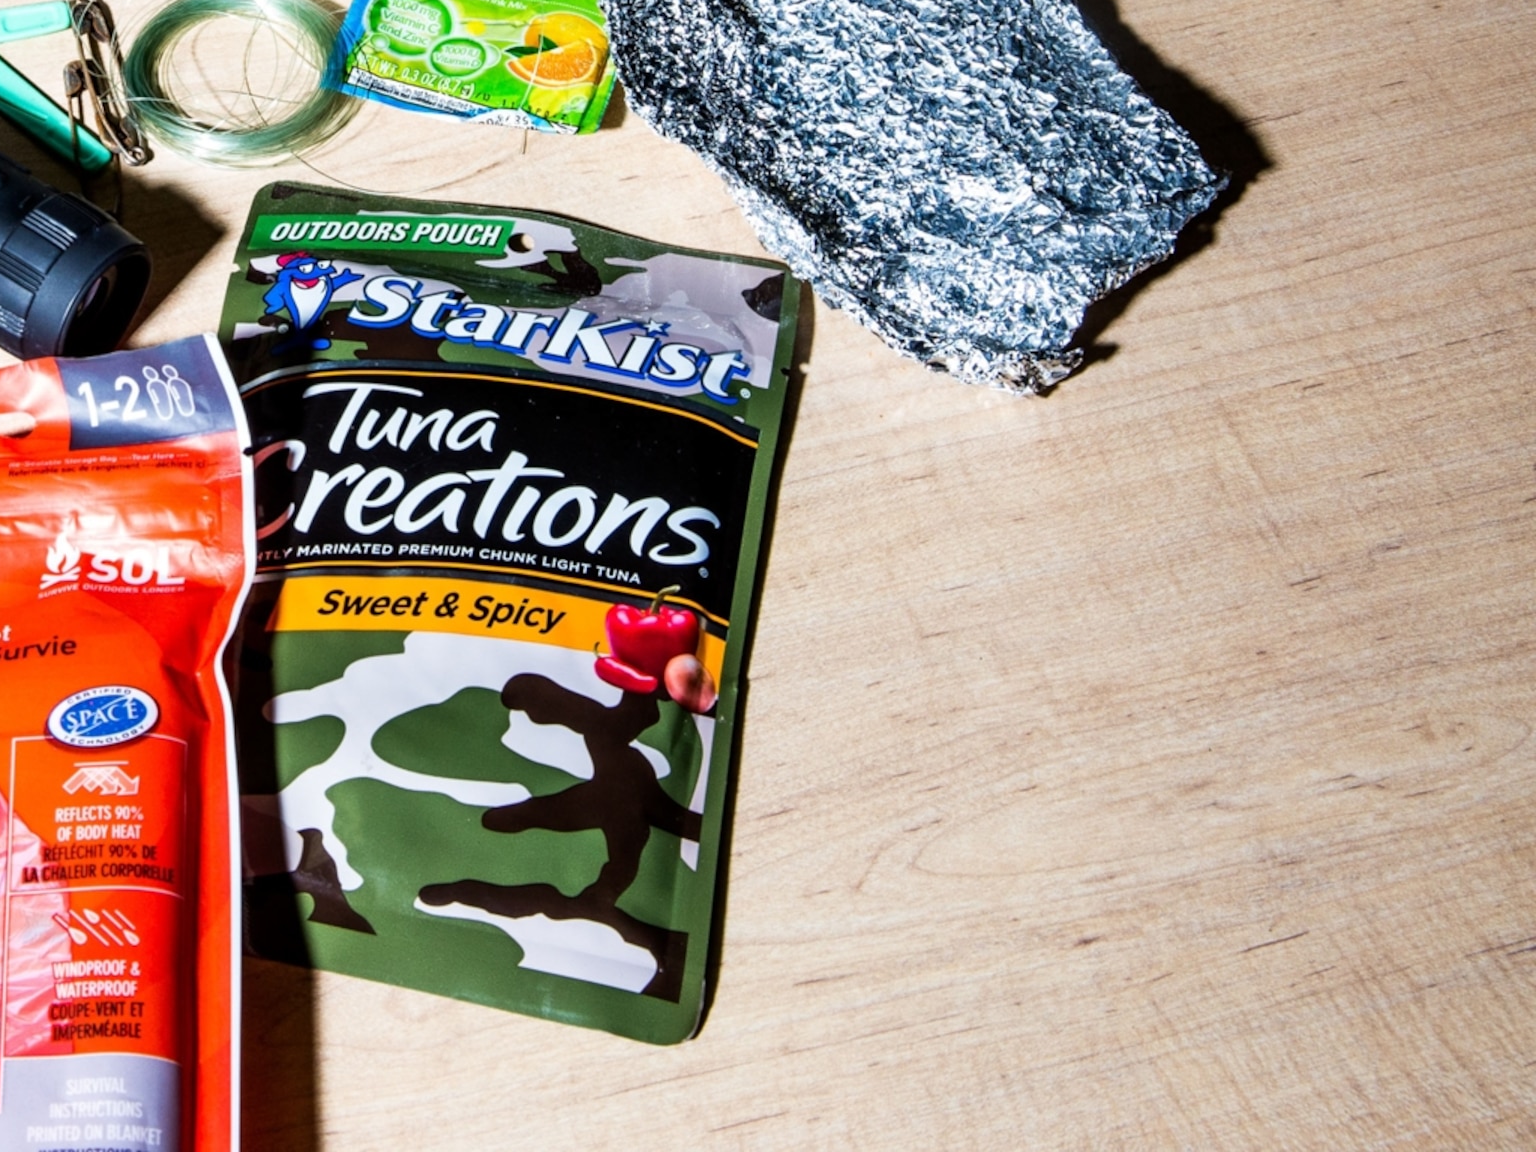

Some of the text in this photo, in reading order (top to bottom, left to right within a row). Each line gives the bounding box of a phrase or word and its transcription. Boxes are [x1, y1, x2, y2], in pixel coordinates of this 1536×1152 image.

[418, 4, 440, 21] mg
[506, 0, 528, 11] Mix
[381, 8, 439, 35] Vitamin C
[378, 22, 430, 46] and Zinc
[433, 51, 481, 68] Vitamin D
[443, 43, 468, 56] 1000
[401, 67, 420, 82] 0.3
[420, 73, 438, 87] OZ
[437, 75, 462, 94] (8.7
[270, 221, 502, 247] OUTDOORS POUCH
[348, 275, 751, 404] StarKist
[77, 374, 148, 428] 1-2
[302, 381, 500, 454] Tuna
[8, 467, 59, 477] Refermable
[61, 466, 76, 474] sac
[78, 464, 89, 472] de
[91, 462, 141, 473] rangement
[64, 454, 97, 465] Storage
[99, 454, 118, 464] Bag
[254, 439, 722, 566] Creations
[86, 547, 186, 586] SOL
[296, 543, 394, 558] MARINATED
[397, 543, 475, 560] PREMIUM
[478, 547, 538, 566] CHUNK
[541, 555, 592, 575] LIGHT
[595, 563, 642, 586] TUNA
[37, 582, 185, 599] SURVIVE OUTDOORS LONGER
[317, 589, 567, 635] Sweet & Spicy
[66, 687, 132, 705] CERTIFIED
[65, 700, 140, 730] SPACE
[64, 724, 145, 745] TECHNOLOGY
[55, 805, 144, 823] REFLECTS 90%
[57, 823, 142, 843] OF BODY HEAT
[43, 841, 157, 863] RÉFLÉCHIT 90% DE
[22, 862, 176, 884] LA CHALEUR CORPORELLE
[52, 959, 141, 980] WINDPROOF &
[55, 980, 138, 1000] WATERPROOF
[49, 1001, 145, 1021] COUPE-VENT ET
[52, 1019, 142, 1041] IMPERMÉABLE
[65, 1077, 127, 1095] SURVIVAL
[49, 1100, 143, 1118] INSTRUCTIONS
[26, 1124, 162, 1146] PRINTED ON BLANKET
